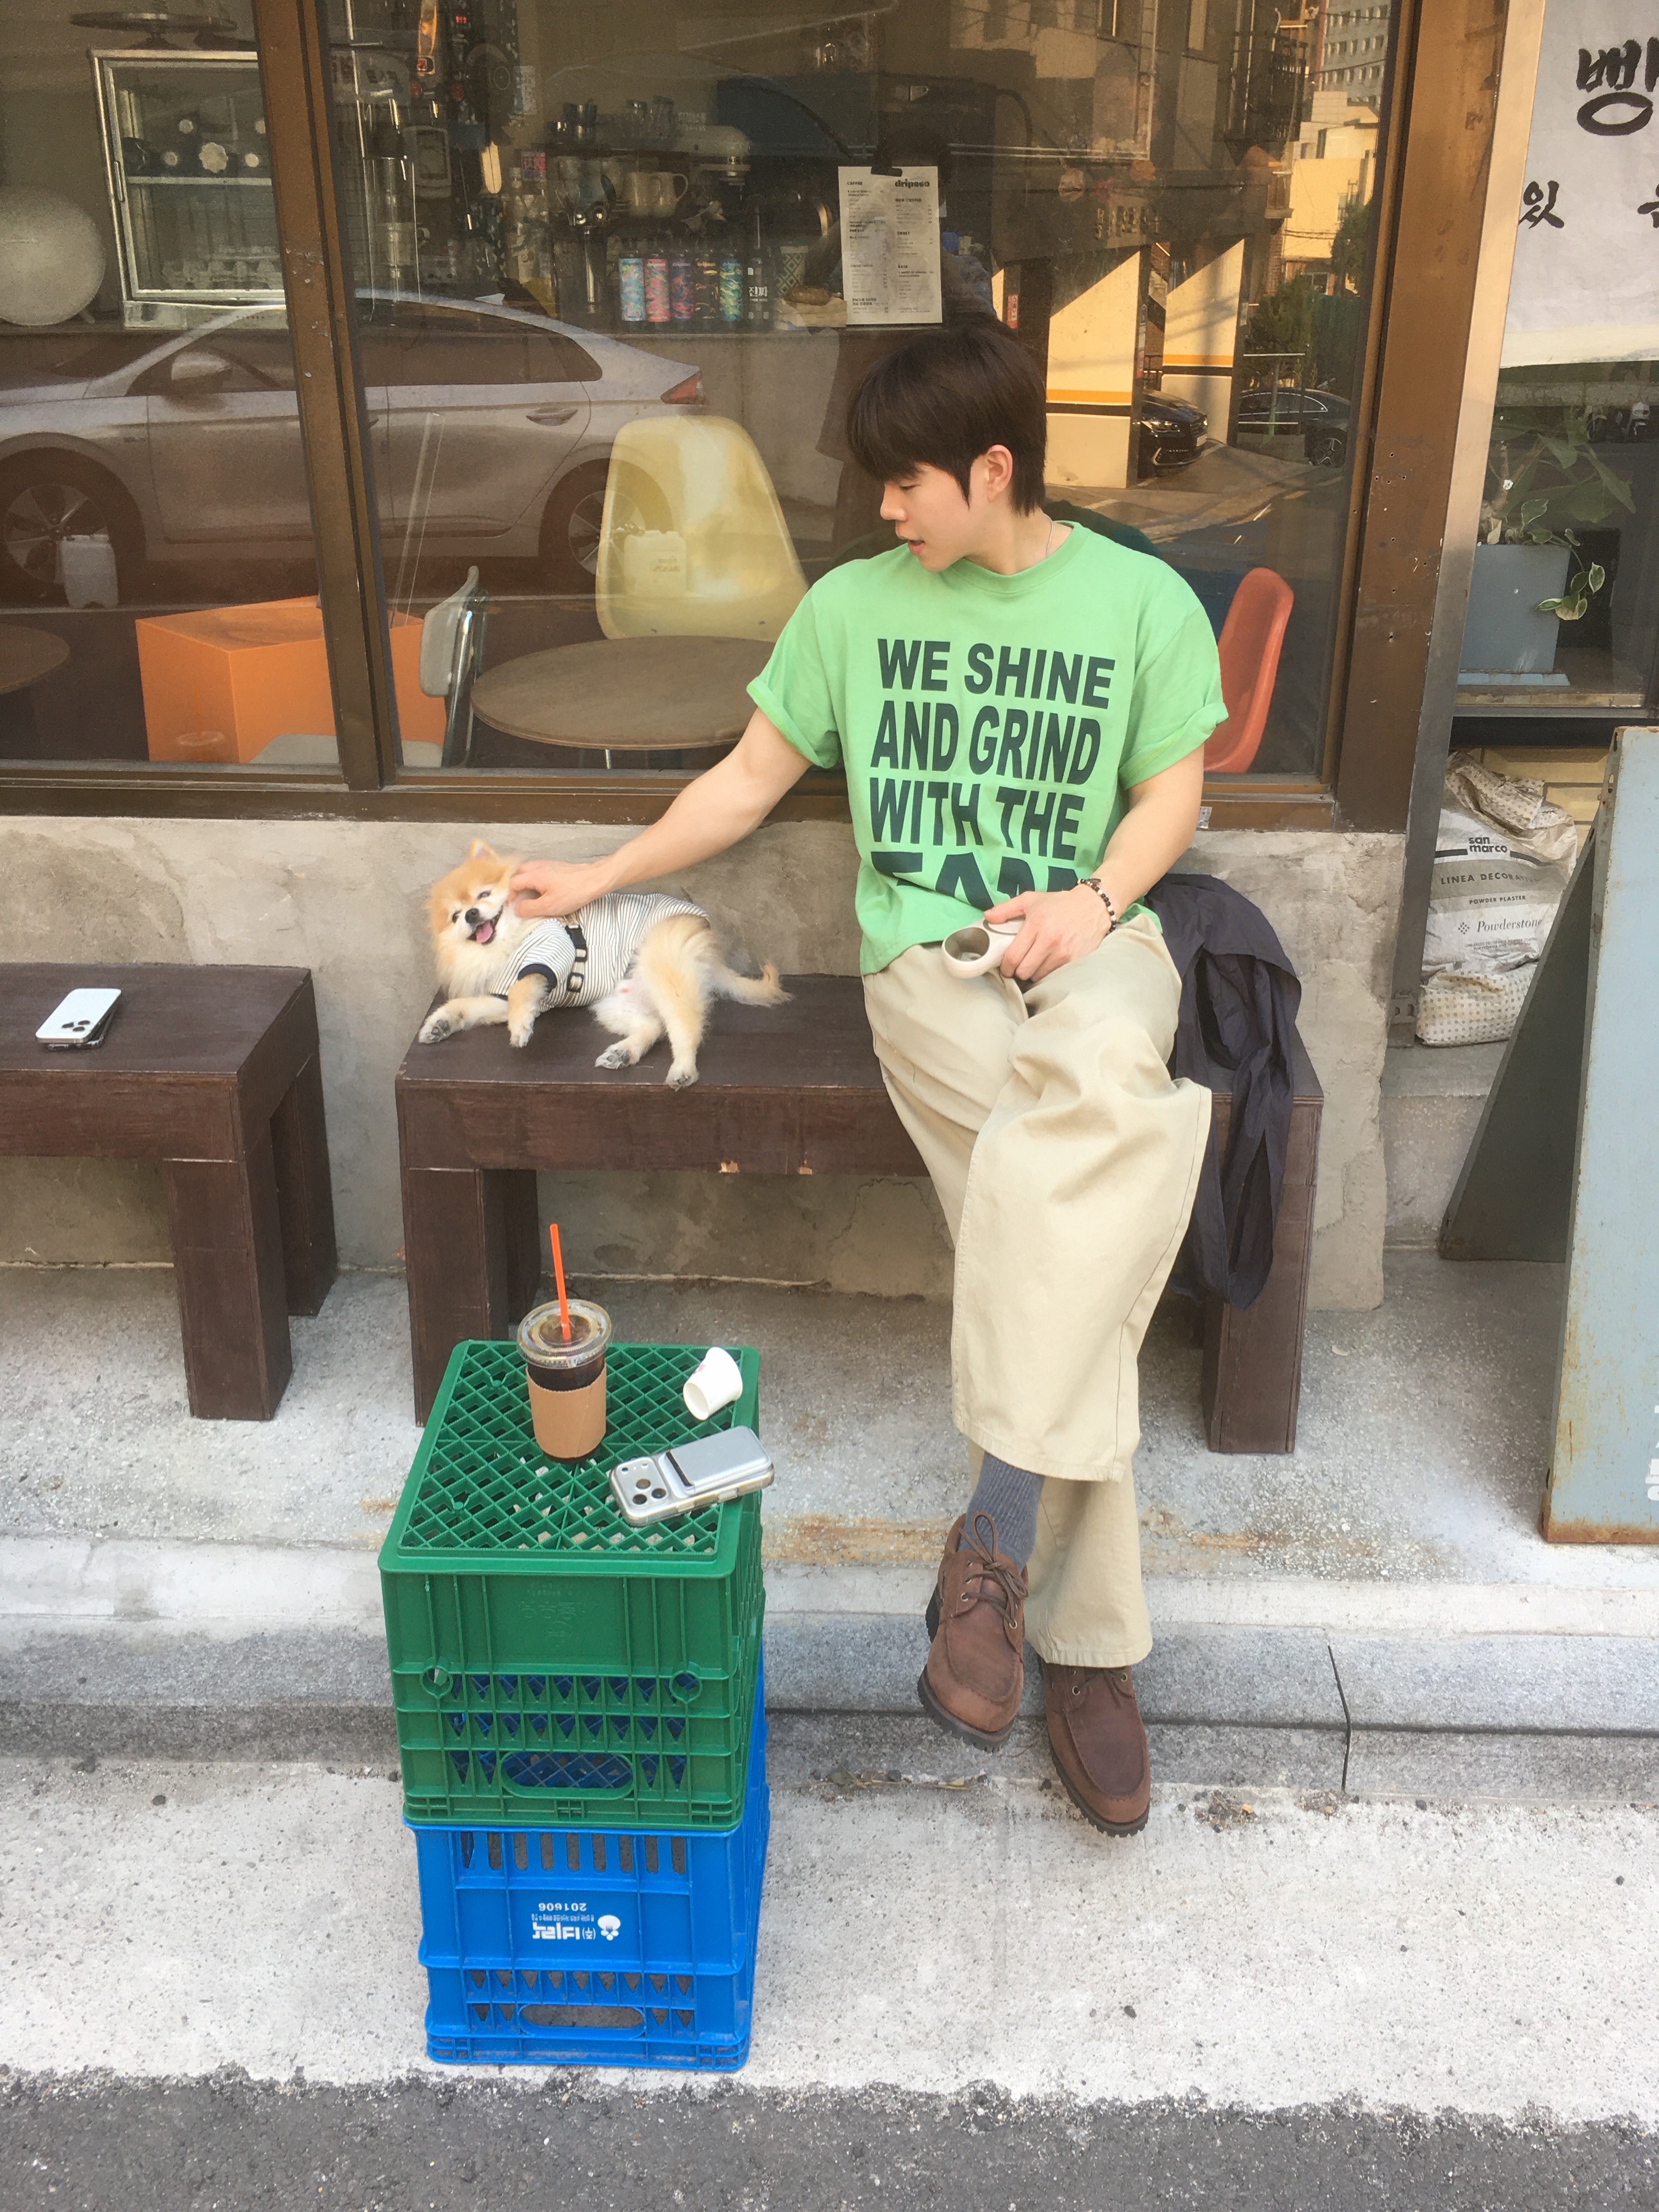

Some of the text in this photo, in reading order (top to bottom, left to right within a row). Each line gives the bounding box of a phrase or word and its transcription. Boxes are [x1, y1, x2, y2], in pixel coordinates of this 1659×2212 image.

[877, 638, 1115, 709] WE SHINE
[870, 700, 1101, 785] AND GRIND
[870, 778, 1085, 861] WITH THE
[1469, 845, 1508, 853] marco
[1441, 874, 1475, 885] LINEA
[538, 1902, 587, 1911] 201606
